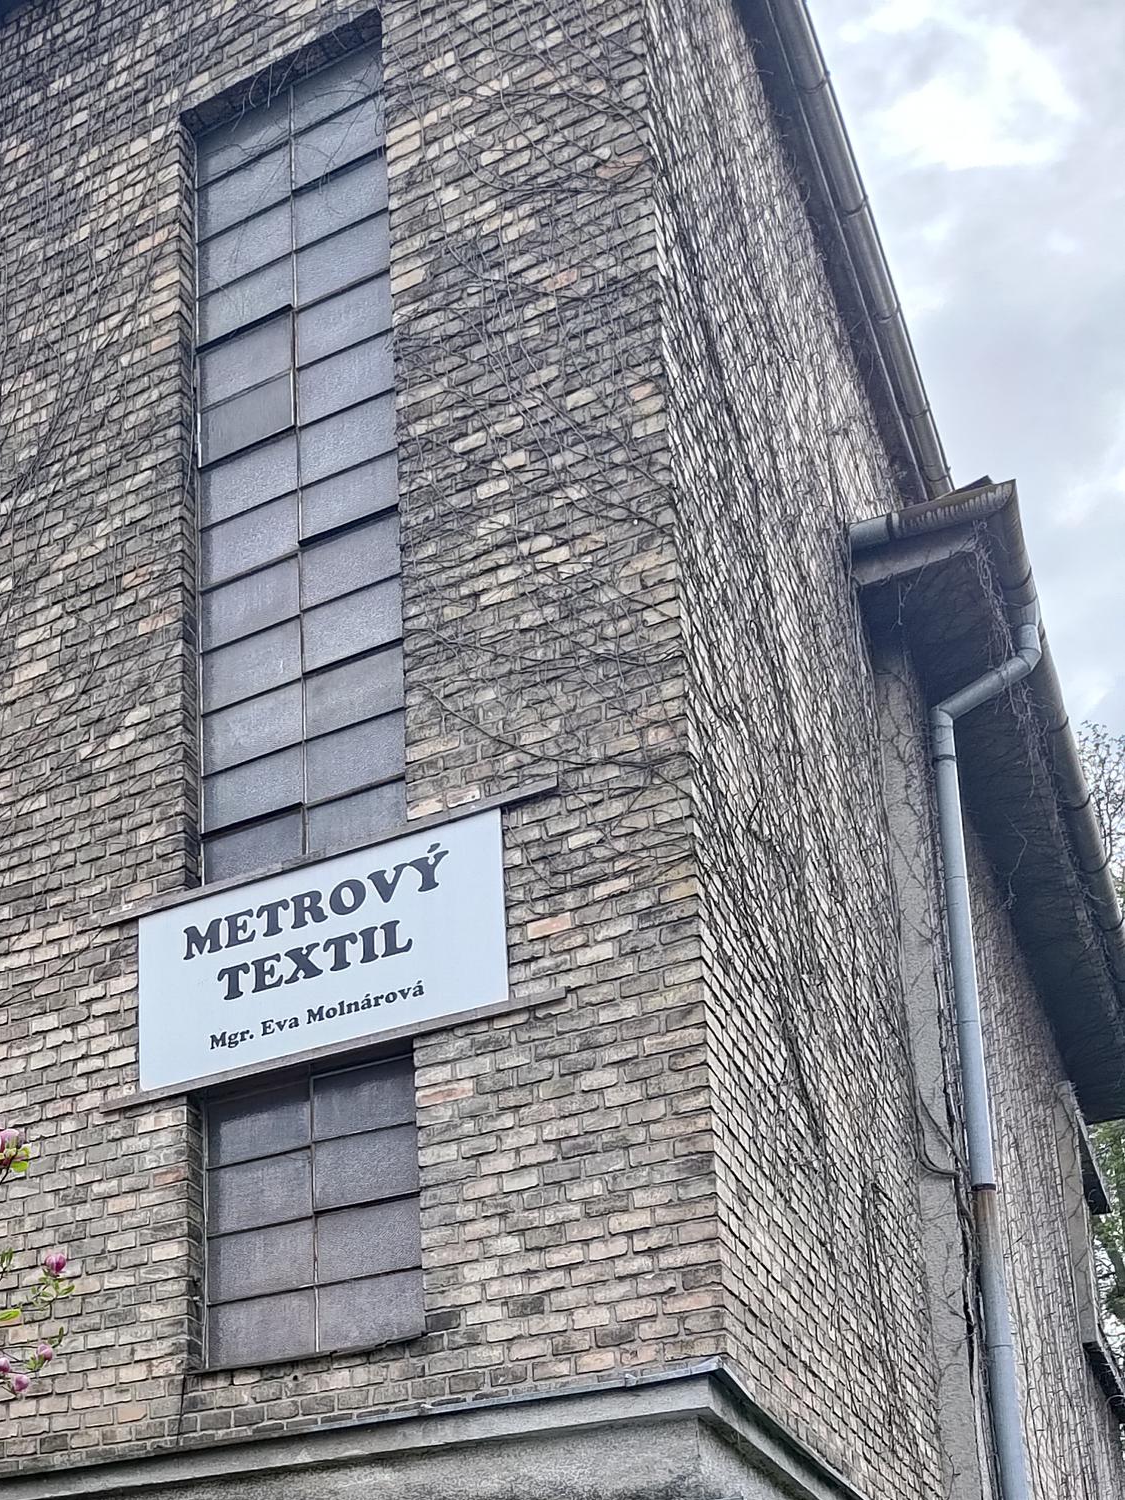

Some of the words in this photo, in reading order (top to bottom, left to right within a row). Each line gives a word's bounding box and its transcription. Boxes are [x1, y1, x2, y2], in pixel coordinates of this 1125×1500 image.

[182, 842, 449, 961] METROVÝ
[217, 919, 413, 1002] TEXTIL
[210, 1027, 254, 1051] Mgr.
[261, 1016, 300, 1037] Eva
[306, 980, 425, 1025] Molnárová
